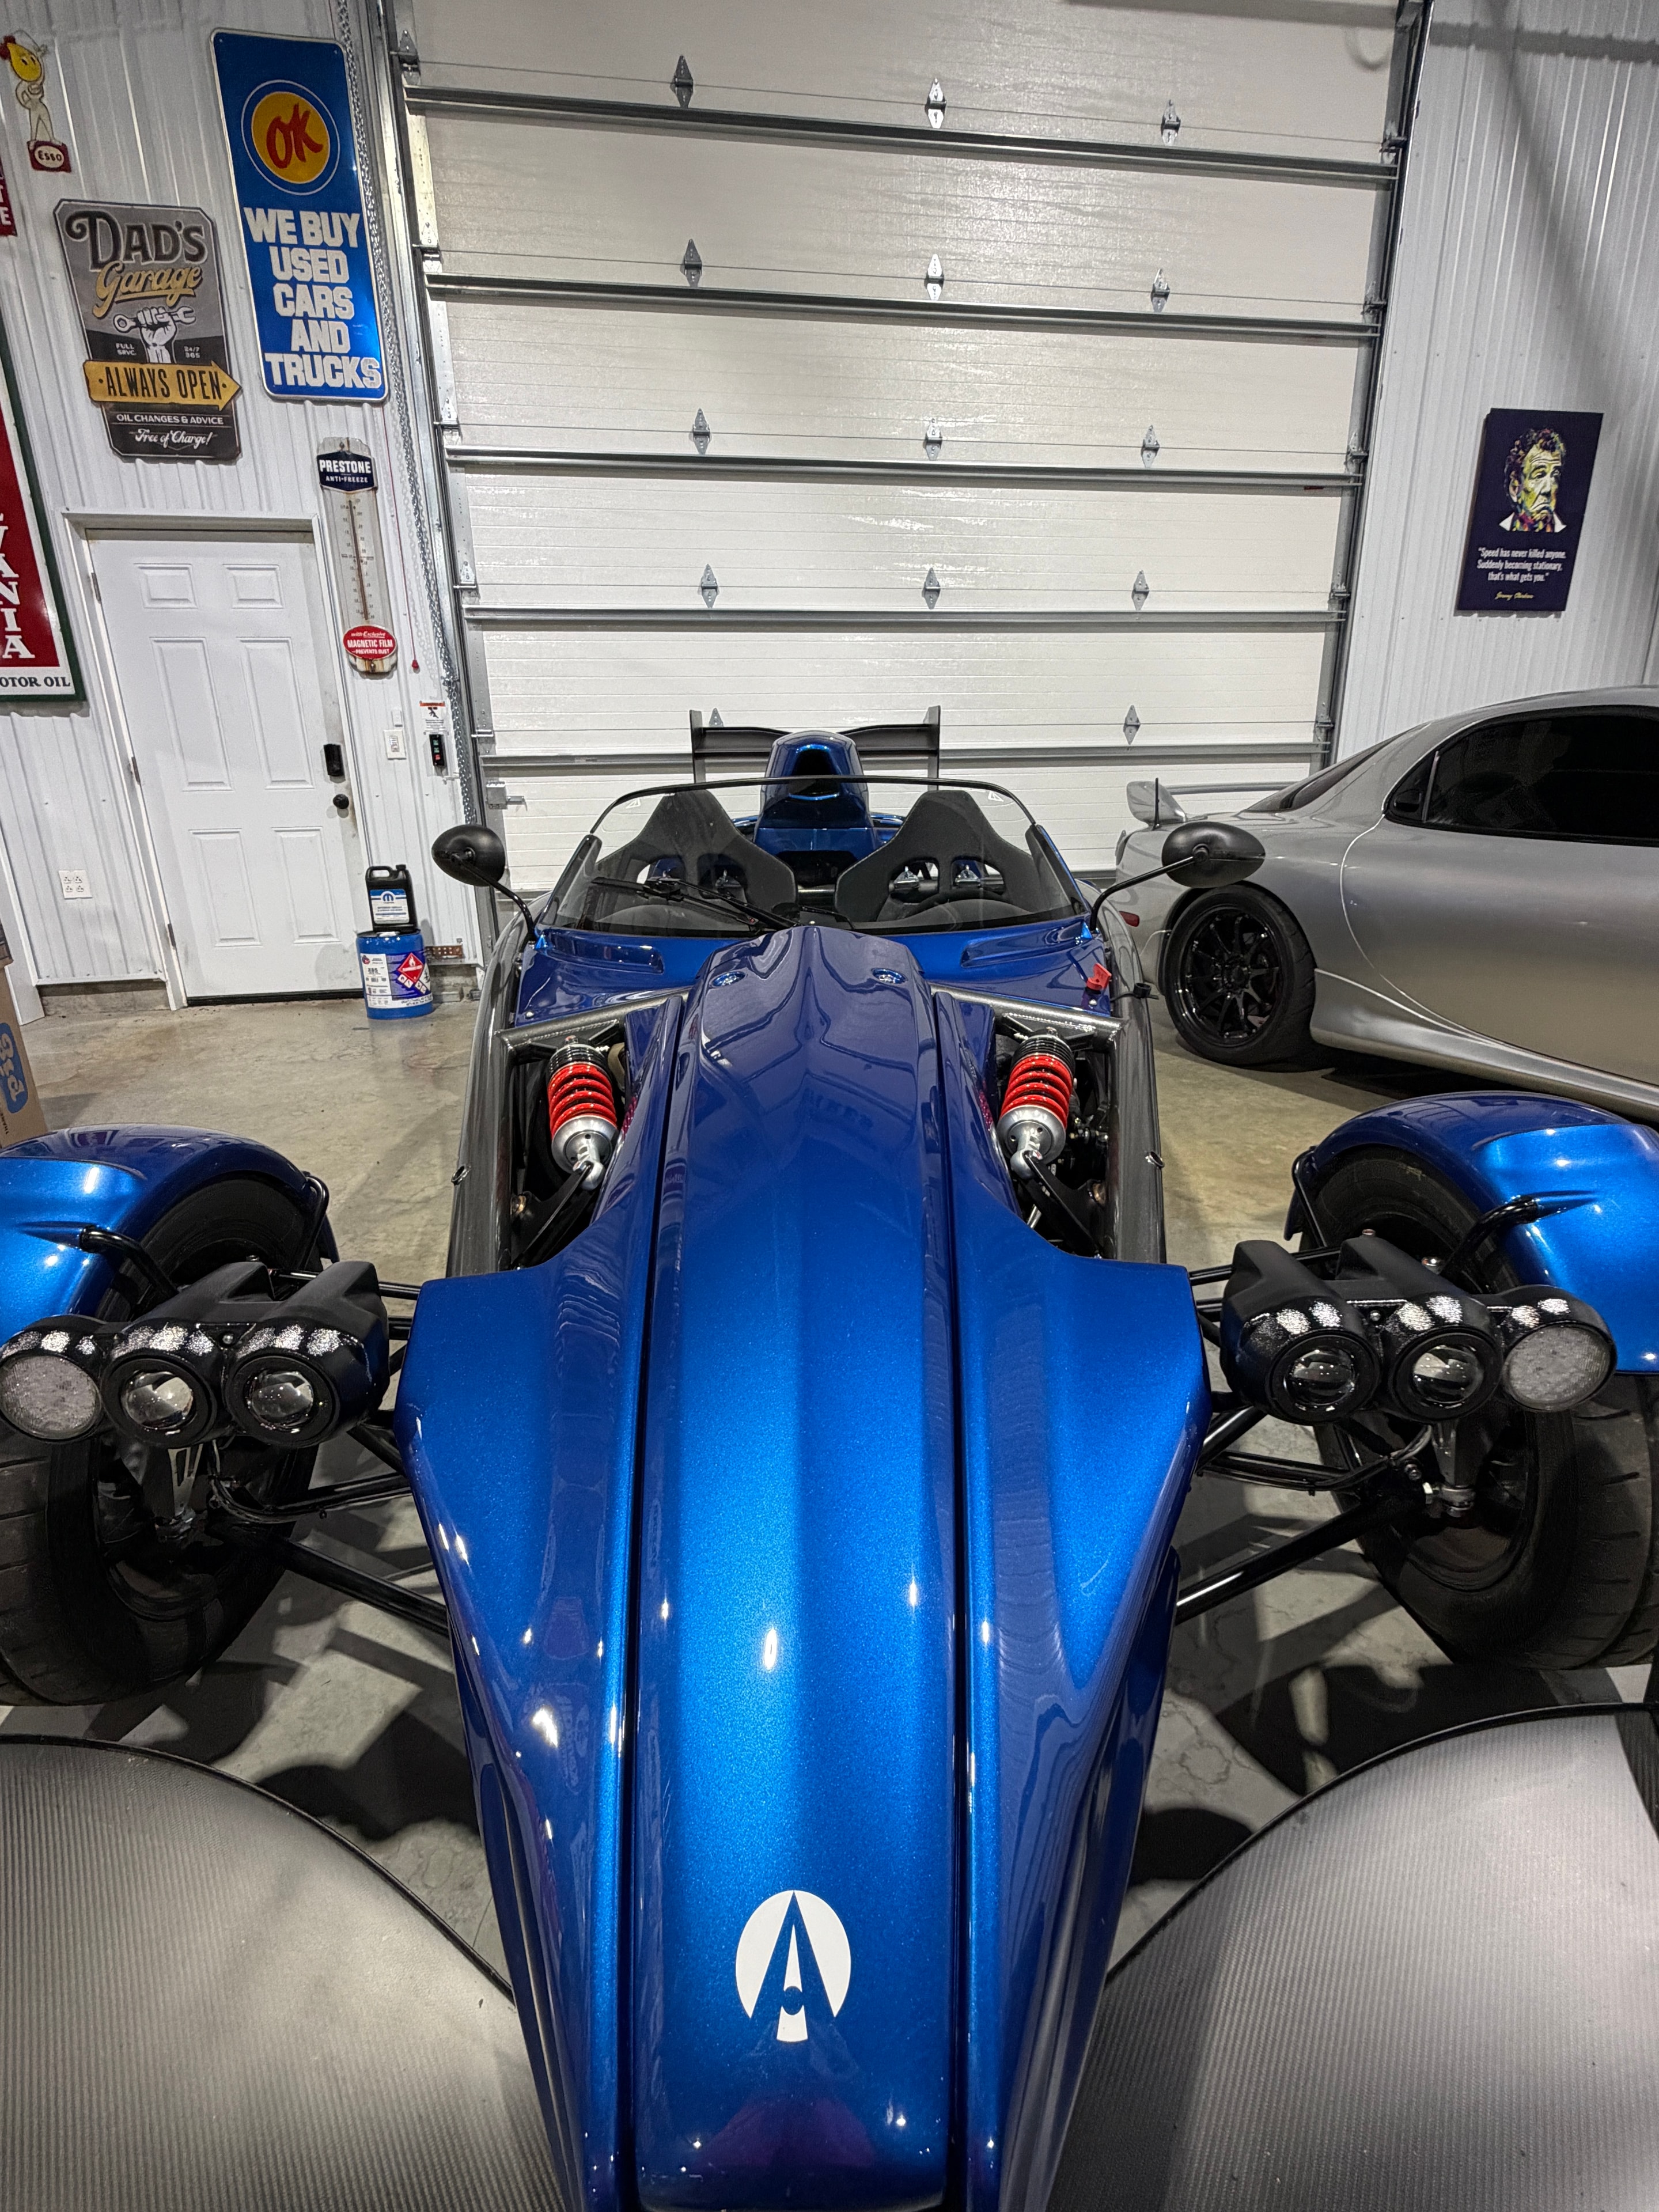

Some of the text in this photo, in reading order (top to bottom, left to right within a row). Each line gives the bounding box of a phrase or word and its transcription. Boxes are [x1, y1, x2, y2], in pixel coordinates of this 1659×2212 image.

[267, 102, 324, 169] OK
[65, 210, 207, 272] DAD'S
[244, 207, 360, 248] WE BUY
[269, 246, 349, 283] USED
[93, 261, 203, 318] Garage
[273, 283, 354, 320] CARS
[291, 319, 351, 354] AND
[105, 366, 222, 400] ALWAYS OPEN
[264, 353, 382, 389] TRUCKS
[116, 414, 133, 422] OIL
[134, 414, 180, 423] CHANGES
[190, 416, 224, 425] ADVICE
[135, 429, 213, 449] Free of Charge!
[319, 460, 372, 474] PRESTONE
[1476, 559, 1504, 570] Suddenly
[1504, 560, 1532, 571] becoming
[1499, 548, 1510, 557] has
[1511, 550, 1528, 558] never
[1528, 548, 1546, 558] killed
[1545, 551, 1566, 560] anyone.
[1488, 571, 1505, 581] that's
[1505, 572, 1520, 581] what
[1520, 572, 1533, 583] gets
[347, 639, 393, 647] MAGNETIC FILM
[44, 676, 71, 687] OIL
